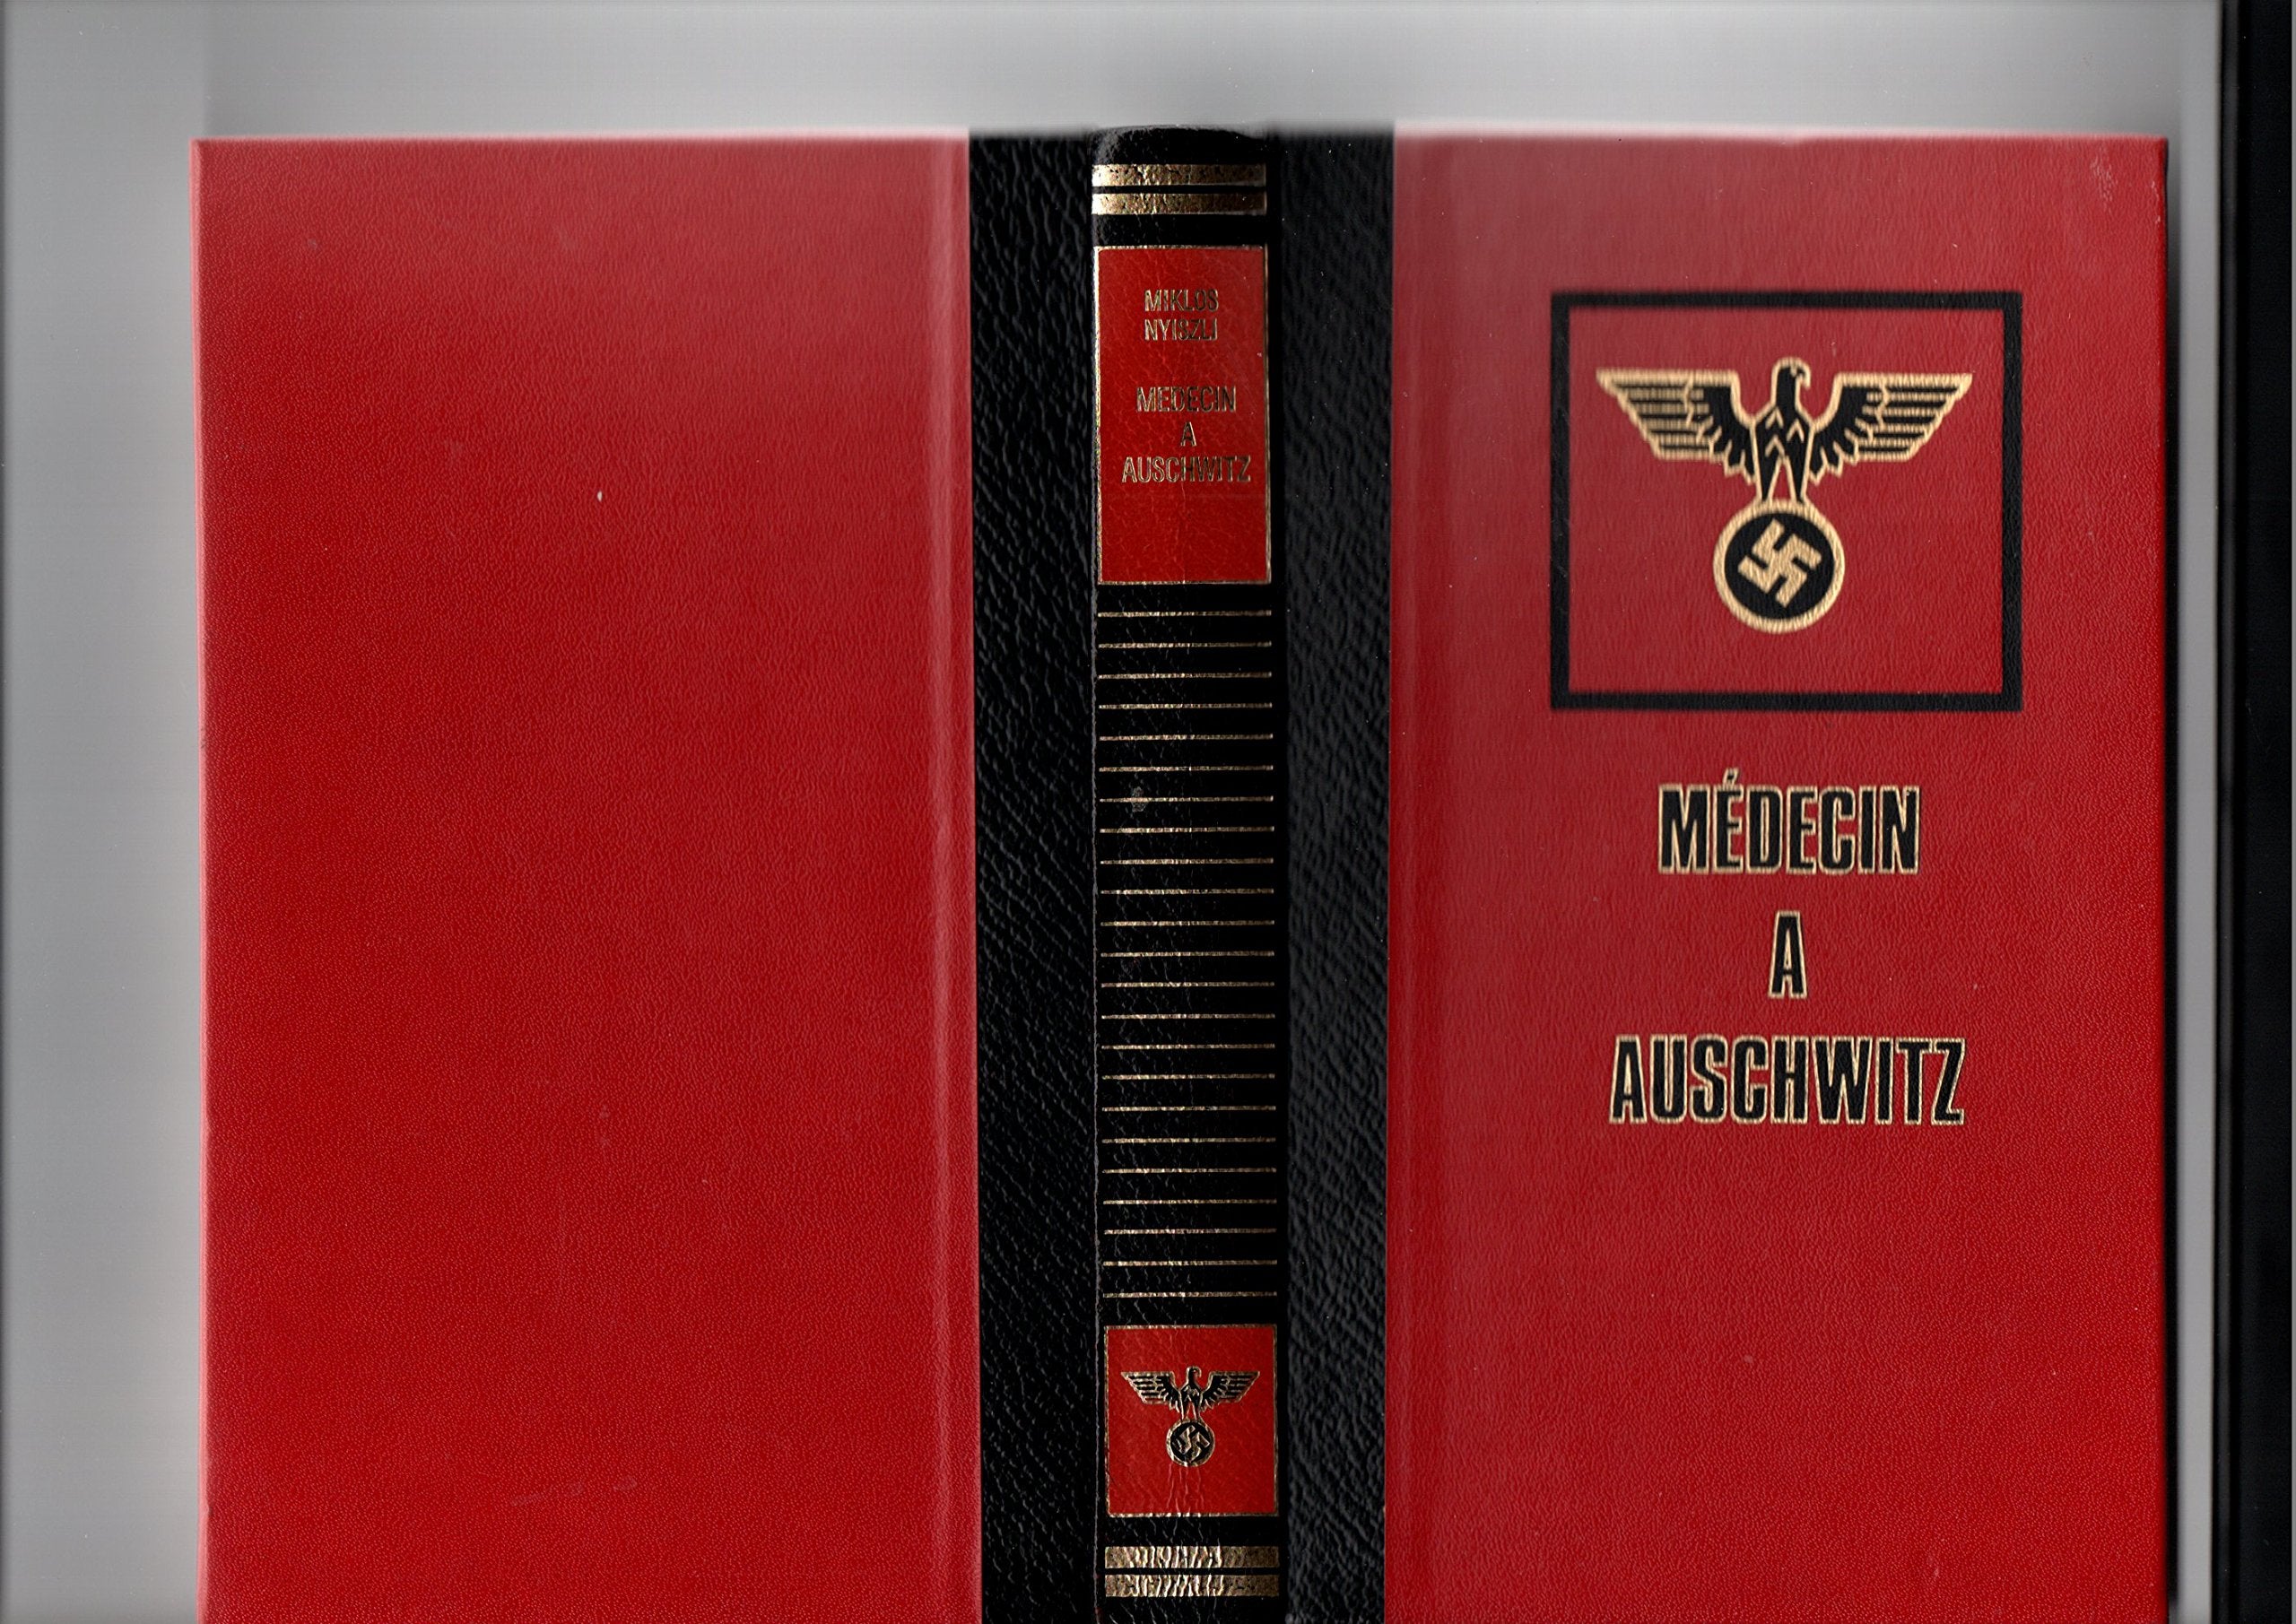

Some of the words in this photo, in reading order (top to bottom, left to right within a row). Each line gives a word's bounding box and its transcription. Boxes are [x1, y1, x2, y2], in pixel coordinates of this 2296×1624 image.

[1144, 289, 1219, 312] MIKLOS
[1144, 318, 1217, 341] NYISZLI
[1136, 386, 1237, 412] MEDECIN
[1180, 421, 1197, 447] A
[1121, 456, 1251, 483] AUSCHWITZ
[1658, 769, 1920, 874] MÉDECIN
[1768, 910, 1808, 998] A
[1609, 1034, 1966, 1125] AUSCHWITZ
